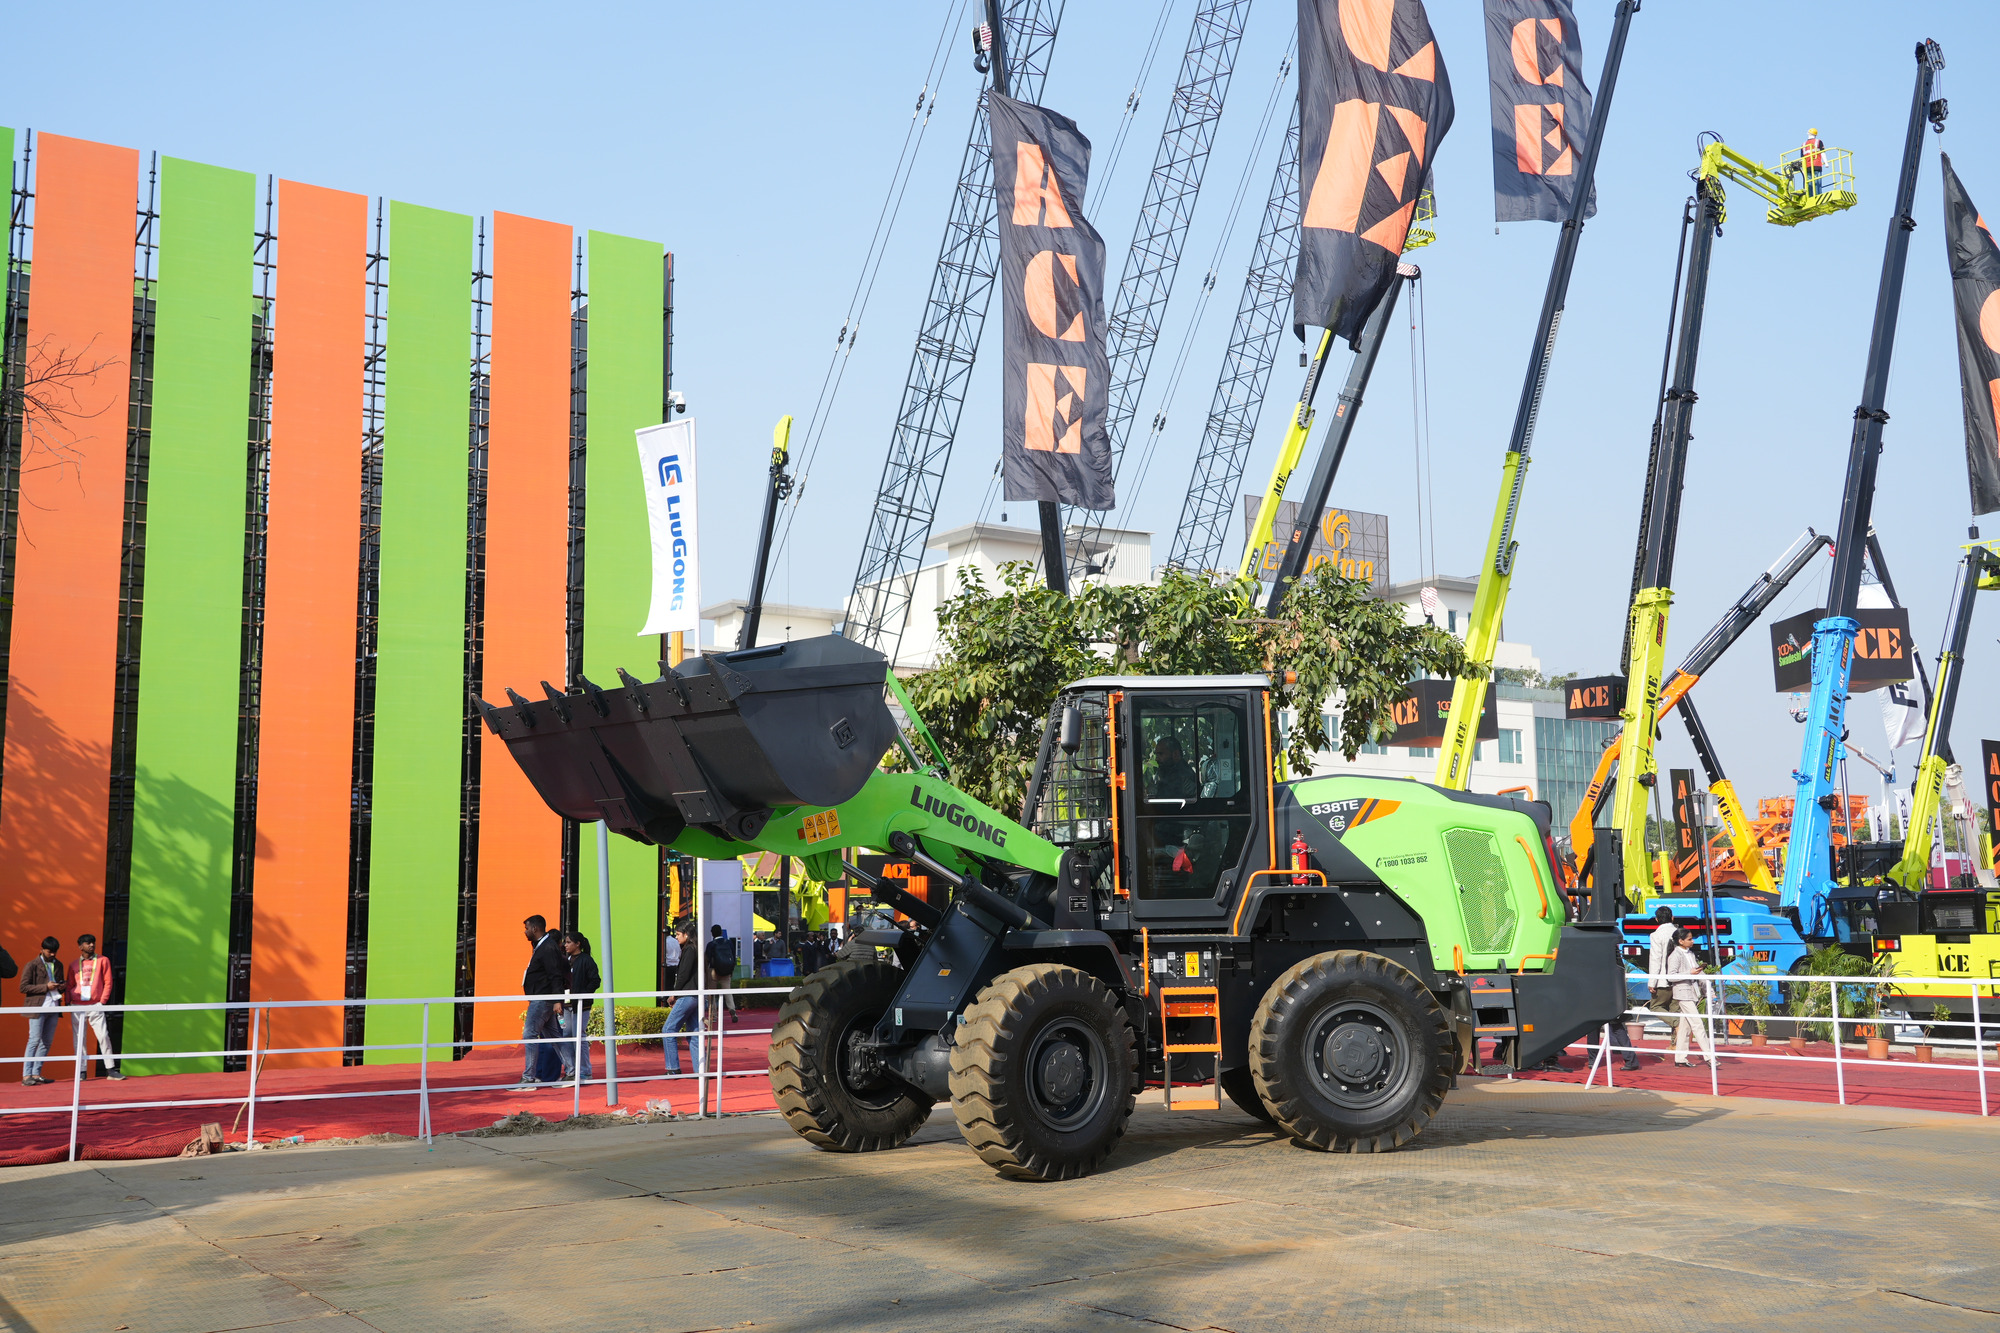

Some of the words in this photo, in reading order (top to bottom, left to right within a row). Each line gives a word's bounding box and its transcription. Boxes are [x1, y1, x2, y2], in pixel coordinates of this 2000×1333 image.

[1012, 141, 1086, 454] ACE
[1336, 404, 1345, 418] ACE
[1273, 473, 1287, 496] ACE
[1293, 530, 1302, 544] ACE
[1852, 628, 1903, 659] CE
[1569, 686, 1609, 710] ACE
[1646, 675, 1658, 711] ACE
[1829, 689, 1842, 727] ACE
[1456, 721, 1467, 748] ACE
[1587, 780, 1601, 801] ACE
[1933, 769, 1943, 795] ACE
[1311, 800, 1359, 815] 838TE
[882, 863, 911, 879] ACE
[1384, 859, 1398, 868] 1800
[1400, 857, 1415, 866] 1033
[1417, 855, 1428, 864] 852
[1753, 951, 1769, 962] ACE
[1938, 954, 1969, 972] ACE
